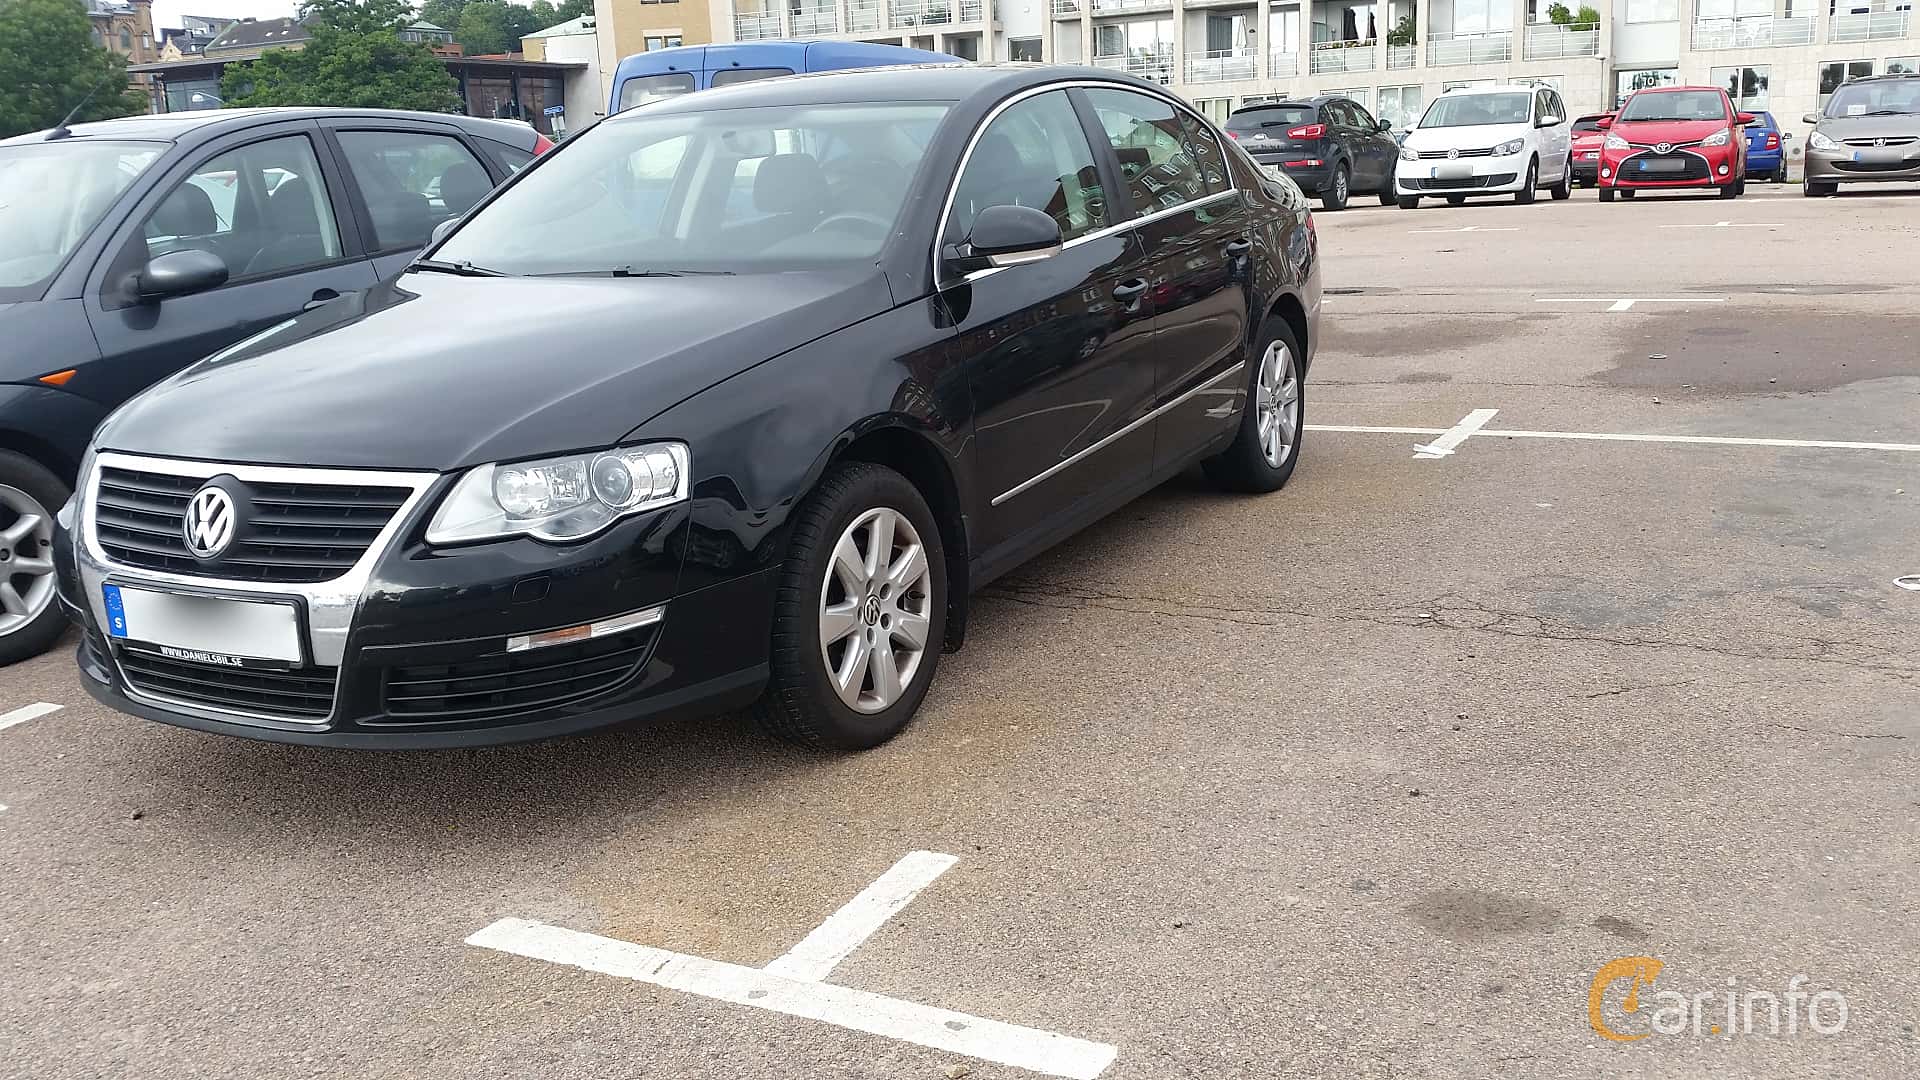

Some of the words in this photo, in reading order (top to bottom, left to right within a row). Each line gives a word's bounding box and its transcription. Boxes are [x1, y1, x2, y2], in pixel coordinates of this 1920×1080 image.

[184, 487, 235, 558] VW
[115, 617, 122, 628] S
[160, 646, 243, 667] WWW.DANIELSBIL.SE
